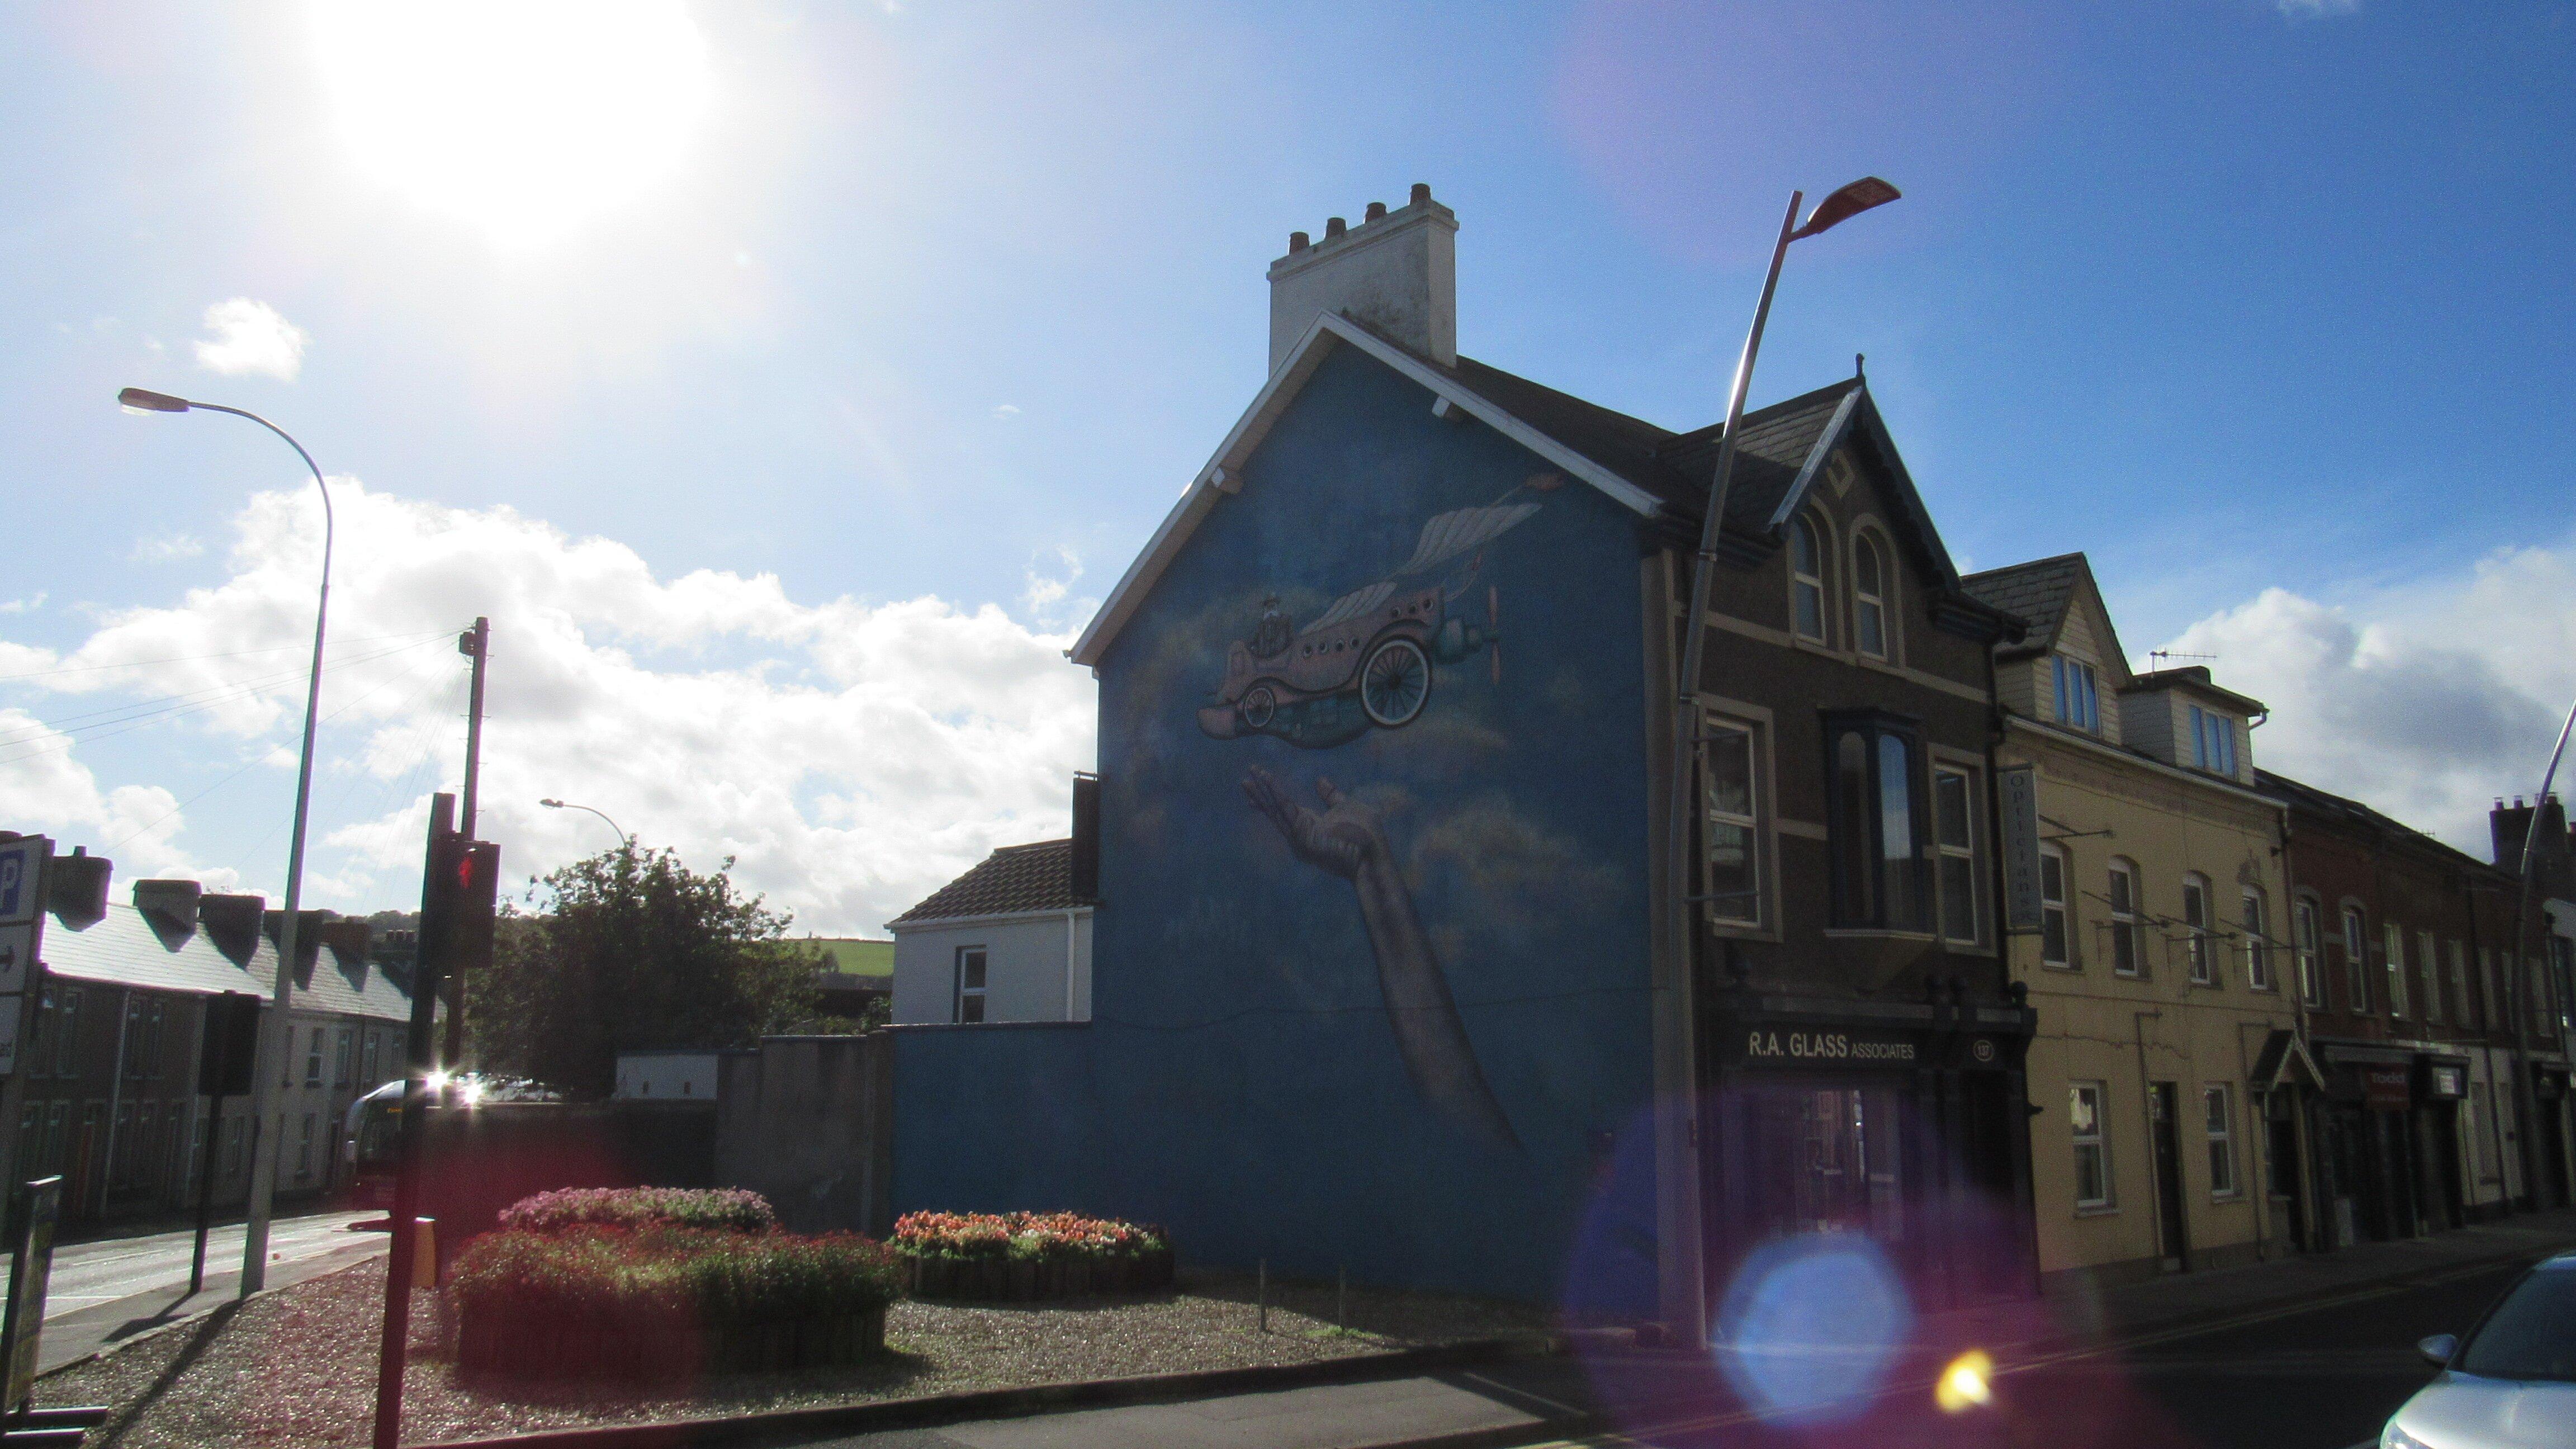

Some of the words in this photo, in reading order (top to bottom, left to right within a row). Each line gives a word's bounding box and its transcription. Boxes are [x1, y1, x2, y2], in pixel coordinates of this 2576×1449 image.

[2010, 775, 2030, 907] Opticians
[0, 858, 18, 909] P
[1749, 1032, 1784, 1055] R.A.
[1789, 1034, 1847, 1058] GLASS
[1852, 1043, 1915, 1059] ASSOCIATES
